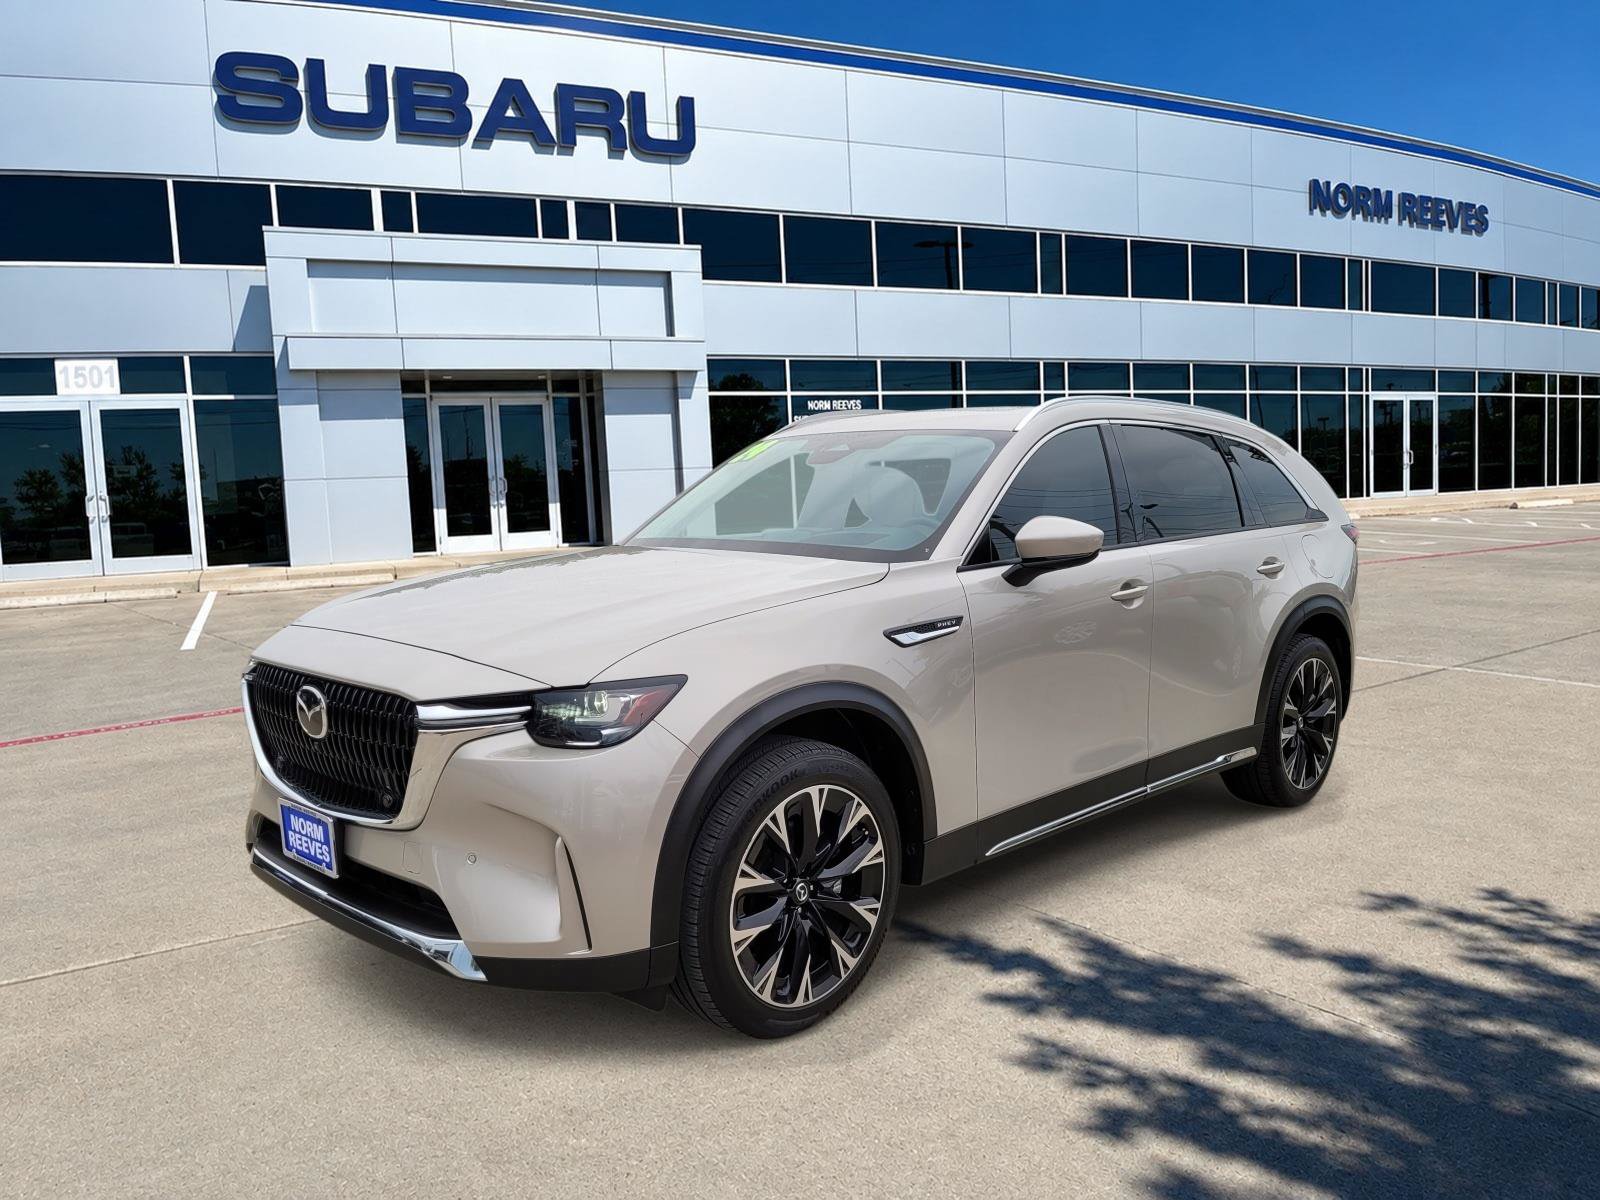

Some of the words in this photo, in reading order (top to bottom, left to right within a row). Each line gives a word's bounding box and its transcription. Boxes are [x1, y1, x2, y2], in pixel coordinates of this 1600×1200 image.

[214, 50, 696, 158] SUBARU
[1308, 179, 1393, 221] NORM
[1398, 192, 1489, 235] REEVES
[59, 364, 115, 389] 1501
[807, 400, 831, 411] NORM
[832, 399, 862, 410] REEVES
[937, 619, 956, 628] PHEV
[290, 814, 324, 842] NORM
[288, 831, 330, 862] REEVES
